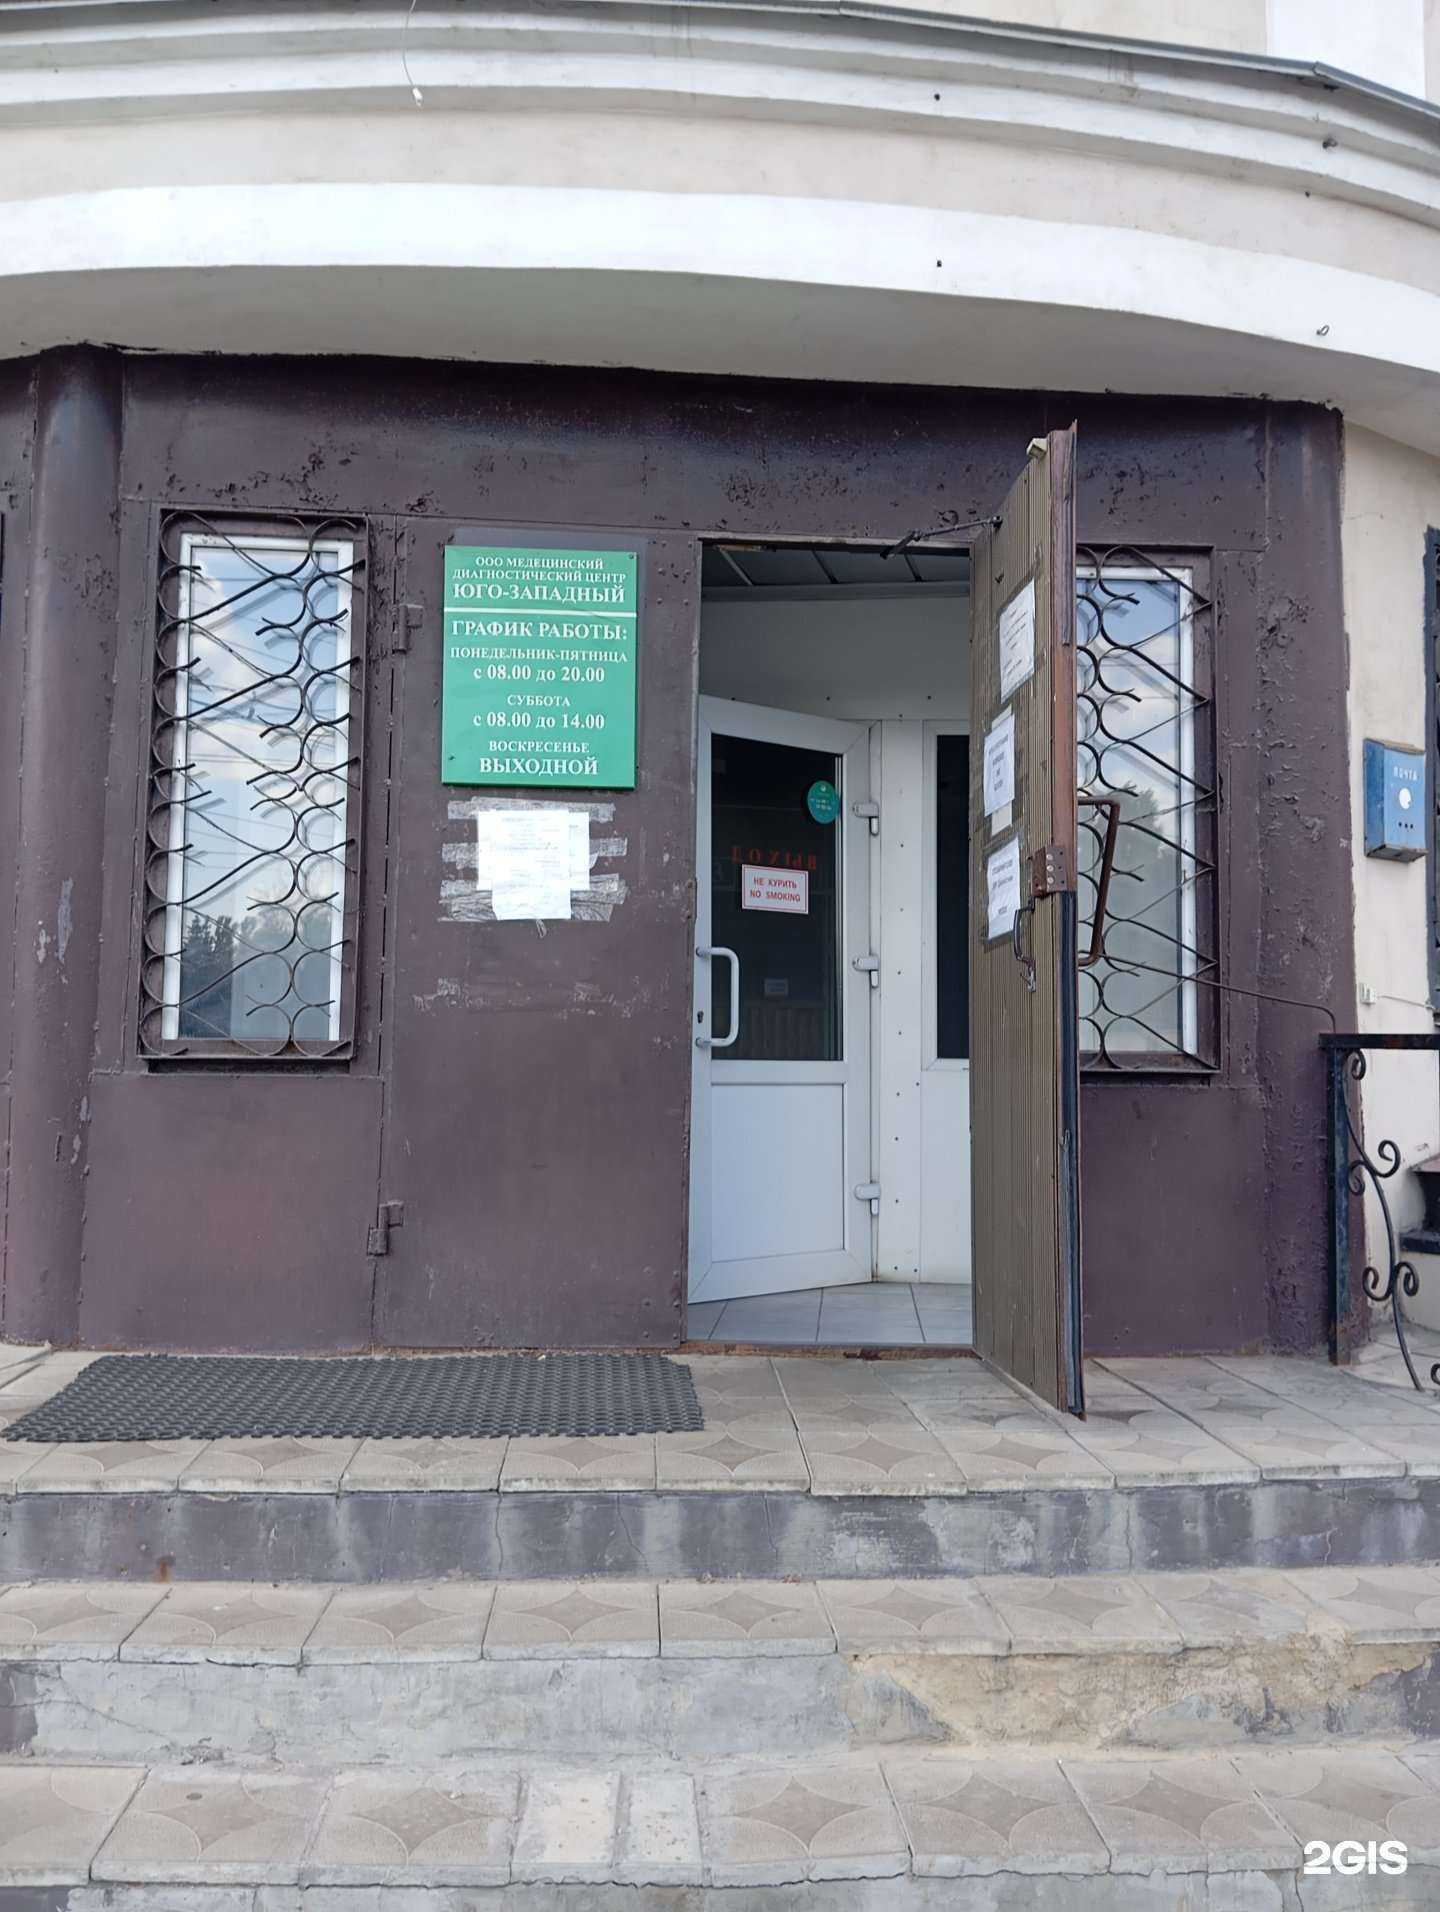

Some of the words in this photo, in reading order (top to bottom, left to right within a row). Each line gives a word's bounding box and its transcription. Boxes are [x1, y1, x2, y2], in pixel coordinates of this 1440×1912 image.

[475, 556, 503, 567] ООО
[452, 569, 582, 582] ДИАГНОСТИЧЕСКИЙ
[585, 573, 626, 584] ЦЕНТР
[454, 583, 625, 604] ЮГО-ЗАПАДНЫЙ
[451, 620, 533, 637] ГРАФИК
[539, 622, 628, 640] РАБОТЫ:
[450, 647, 628, 663] ПОНЕДЕЛЬНИК-ПЯТНИЦА
[473, 667, 482, 679] с
[487, 664, 532, 681] 08.00
[535, 671, 556, 683] до
[561, 666, 605, 682] 20.00
[507, 694, 571, 707] СУББОТА
[473, 714, 482, 727] с
[486, 711, 532, 728] 08.00
[535, 717, 556, 729] до
[561, 713, 605, 729] 14.00
[489, 740, 590, 753] ВОСКРЕСЕНЬЕ
[479, 756, 599, 777] ВЫХОДНОЙ
[753, 876, 765, 886] НЕ
[768, 878, 798, 889] КУРИТЬ
[749, 889, 762, 898] NO
[766, 891, 801, 902] SMOKING
